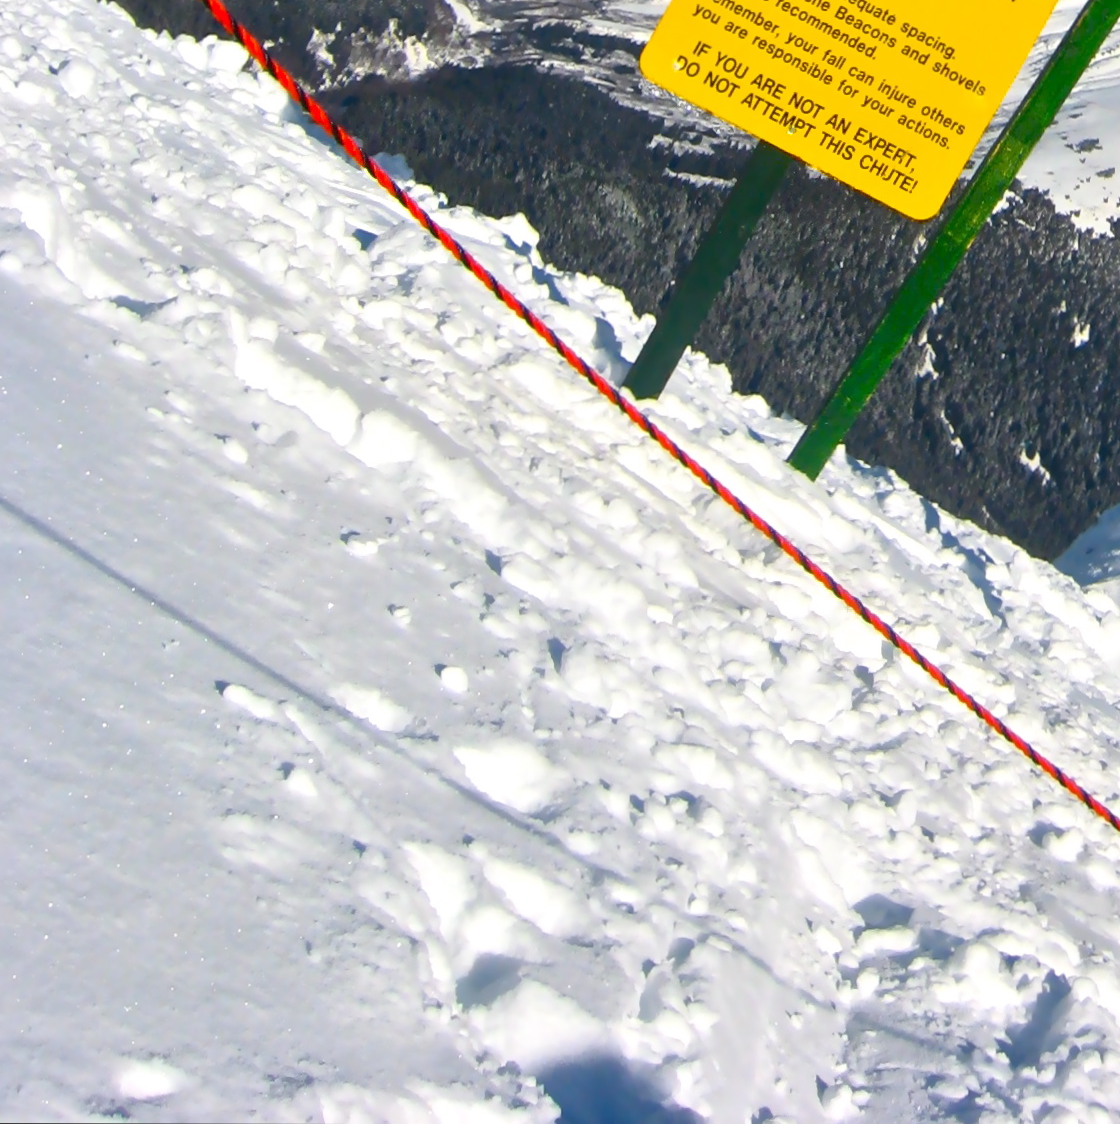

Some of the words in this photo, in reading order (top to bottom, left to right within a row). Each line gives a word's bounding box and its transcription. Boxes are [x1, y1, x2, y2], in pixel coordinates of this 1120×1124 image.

[691, 3, 721, 25] you
[723, 21, 749, 40] are
[751, 35, 833, 86] responsible
[837, 79, 860, 99] for
[860, 95, 895, 118] your
[897, 114, 950, 150] actions.
[784, 32, 820, 55] your
[821, 49, 847, 70] fall
[847, 66, 875, 87] can
[877, 78, 917, 109] injure
[920, 105, 966, 136] others
[834, 5, 897, 49] Beacons
[900, 44, 931, 66] and
[931, 61, 986, 96] shovels
[899, 22, 956, 60] spacing.
[676, 54, 701, 78] DO
[702, 70, 741, 98] NOT
[740, 92, 817, 138] ATTEMPT
[819, 130, 856, 161] THIS
[859, 154, 919, 194] CHUTE!
[692, 40, 713, 57] IF
[714, 51, 750, 80] YOU
[749, 73, 787, 101] ARE
[787, 91, 826, 120] NOT
[824, 113, 852, 136] AN
[852, 126, 917, 174] EXPERT,
